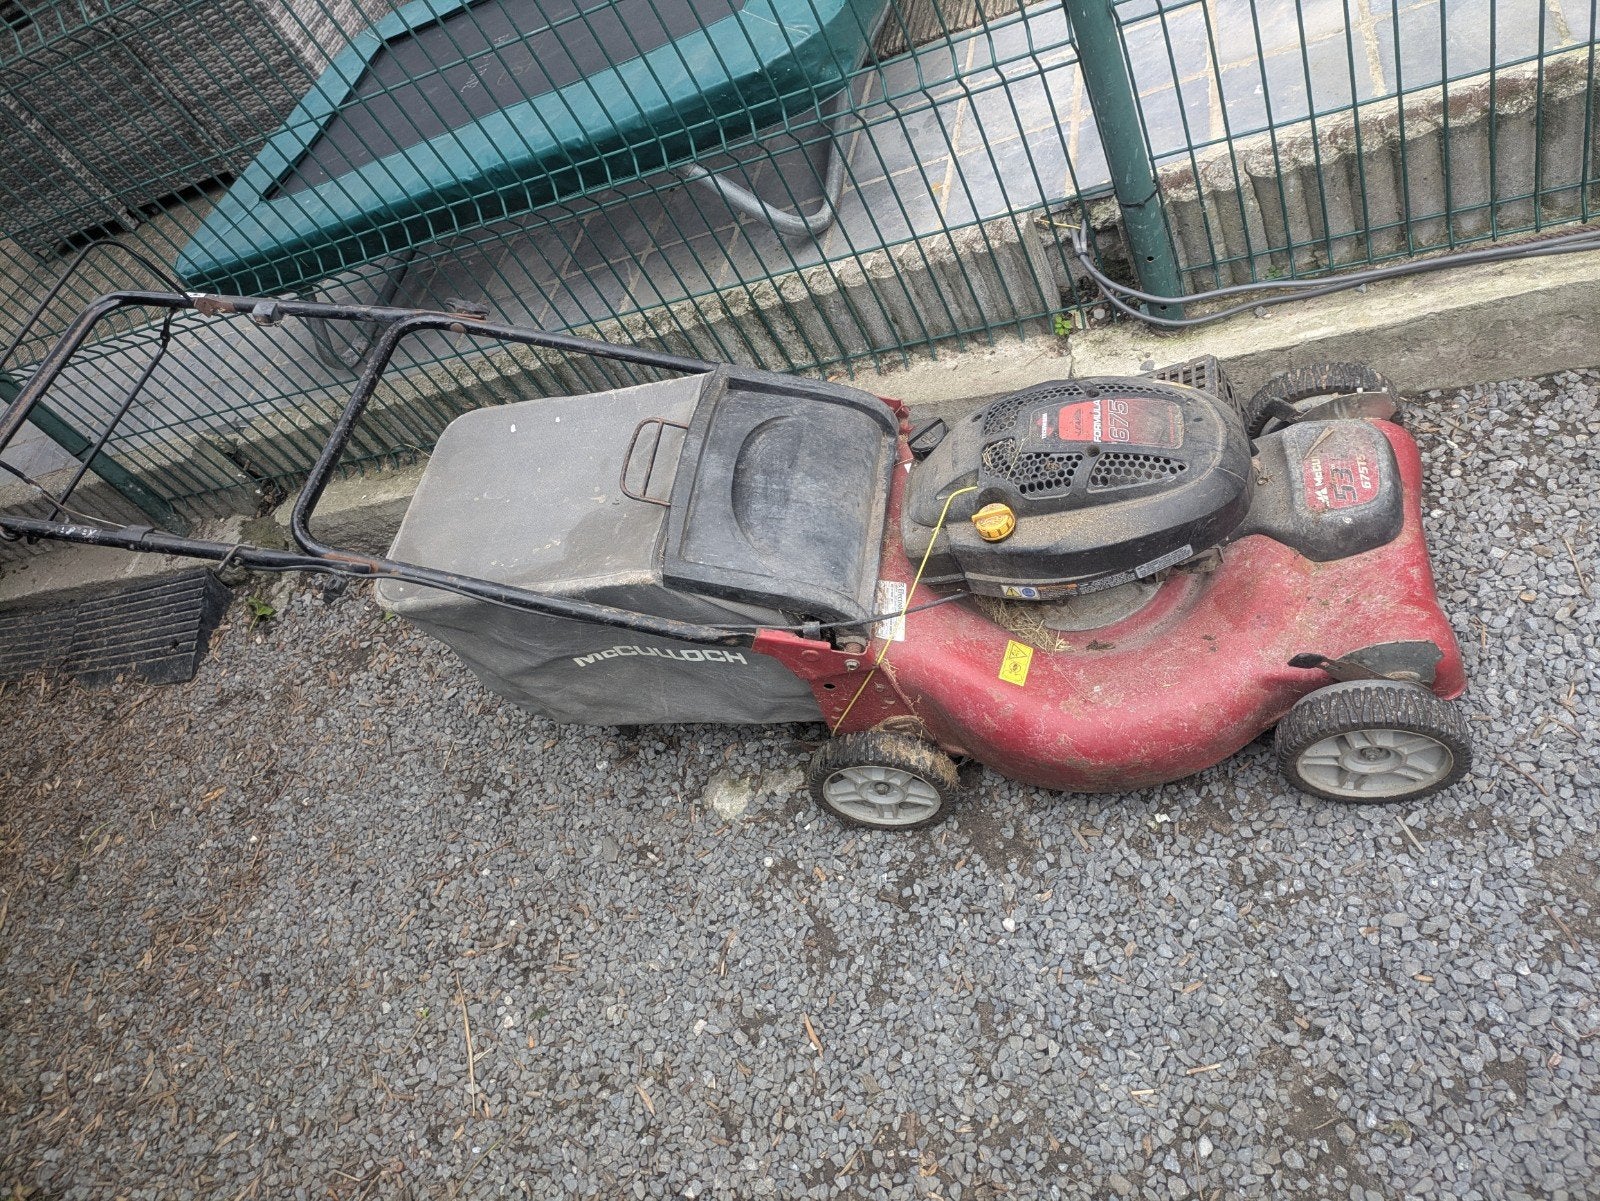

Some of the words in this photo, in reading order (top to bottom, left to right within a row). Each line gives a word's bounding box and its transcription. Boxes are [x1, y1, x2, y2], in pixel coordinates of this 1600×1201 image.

[1093, 399, 1102, 443] FORMULA
[1108, 399, 1130, 442] 675
[1329, 466, 1358, 502] 53
[572, 645, 748, 668] McCULLOCH
